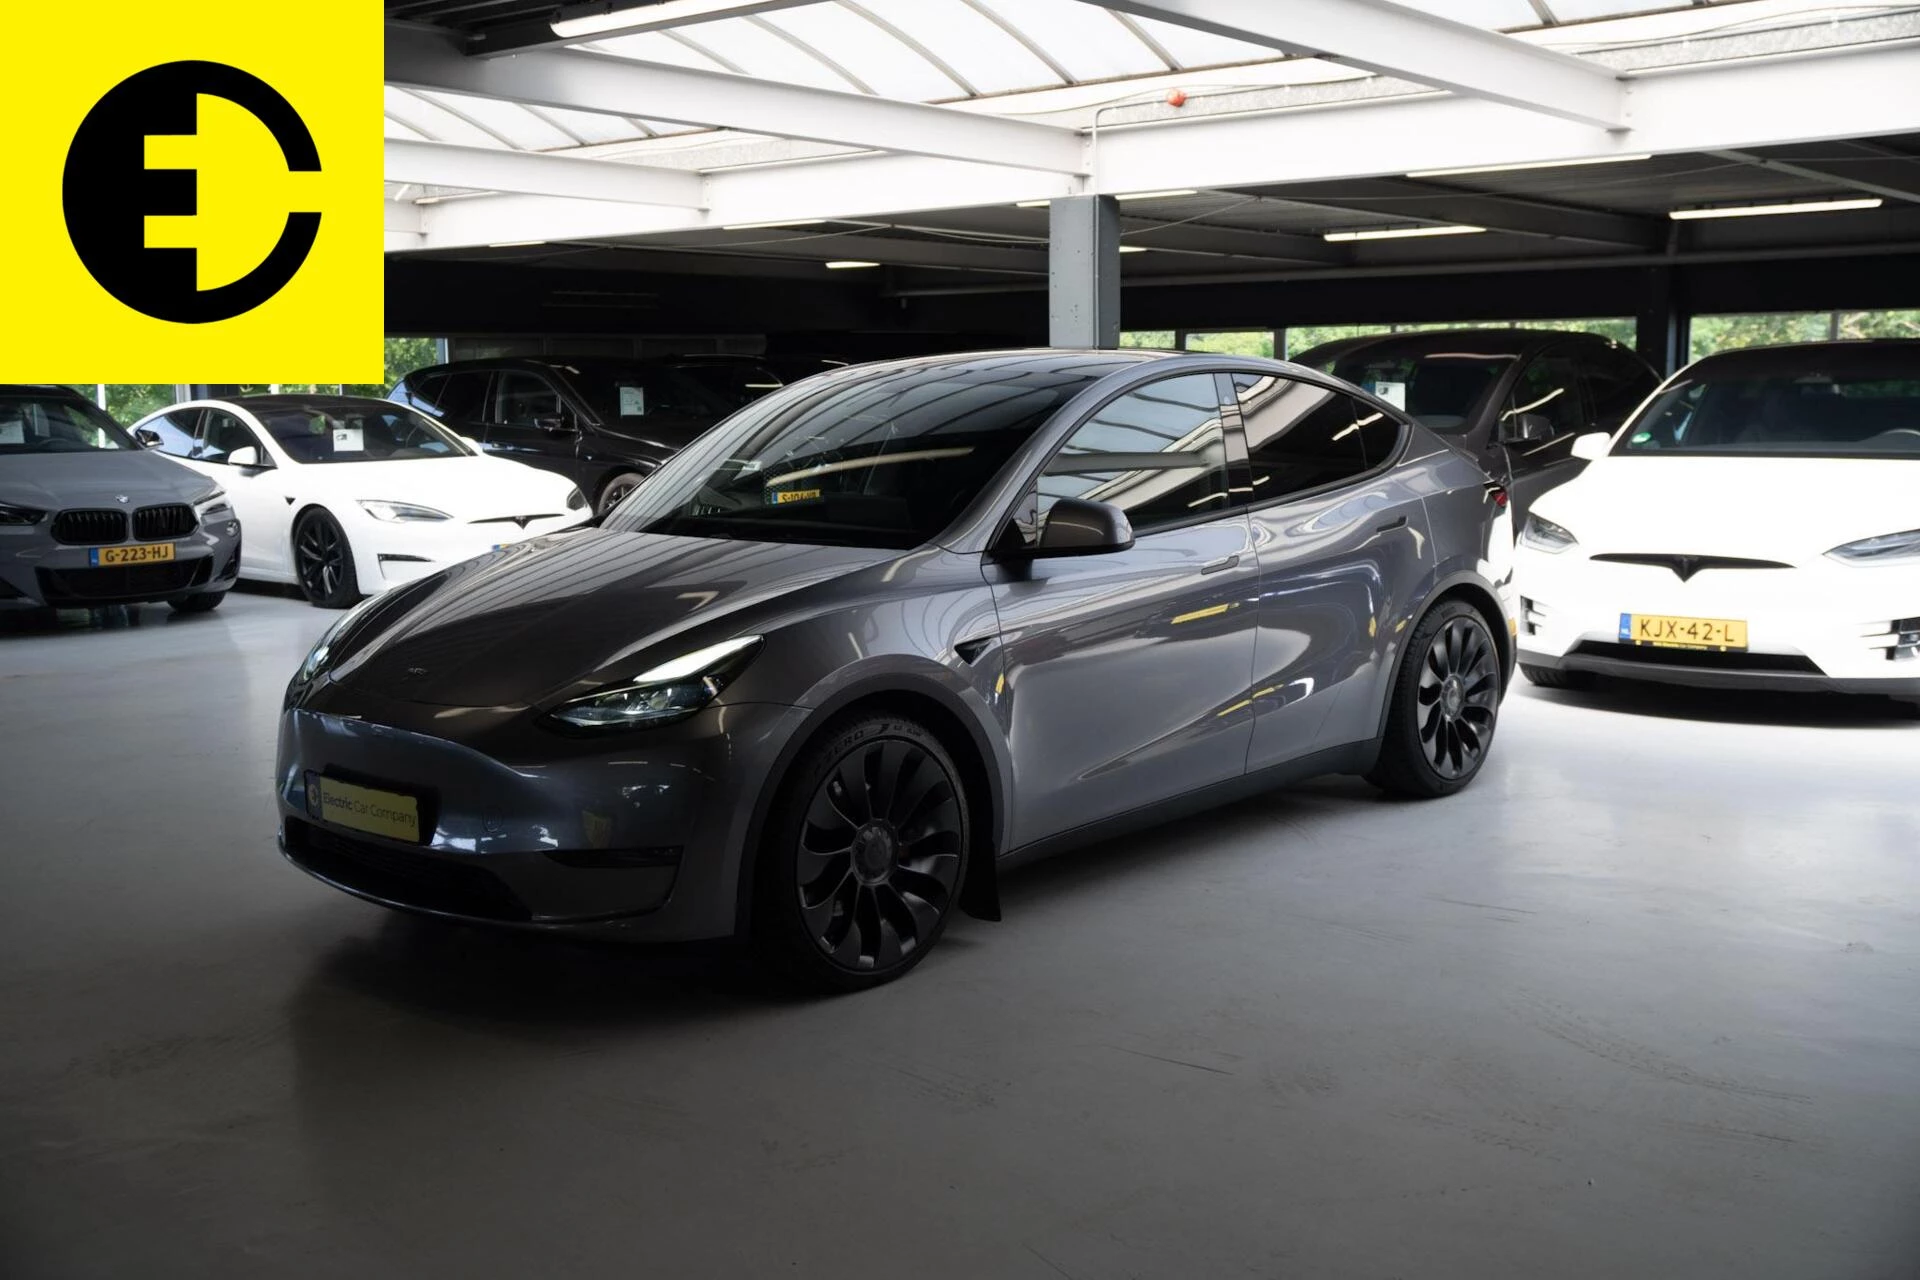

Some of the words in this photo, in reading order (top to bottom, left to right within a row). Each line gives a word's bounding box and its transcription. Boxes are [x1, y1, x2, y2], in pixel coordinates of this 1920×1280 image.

[105, 545, 168, 563] G-223-HJ
[1640, 618, 1735, 643] KJX-42-L
[323, 791, 353, 811] Electric
[354, 801, 369, 815] Car
[370, 804, 417, 827] Company
